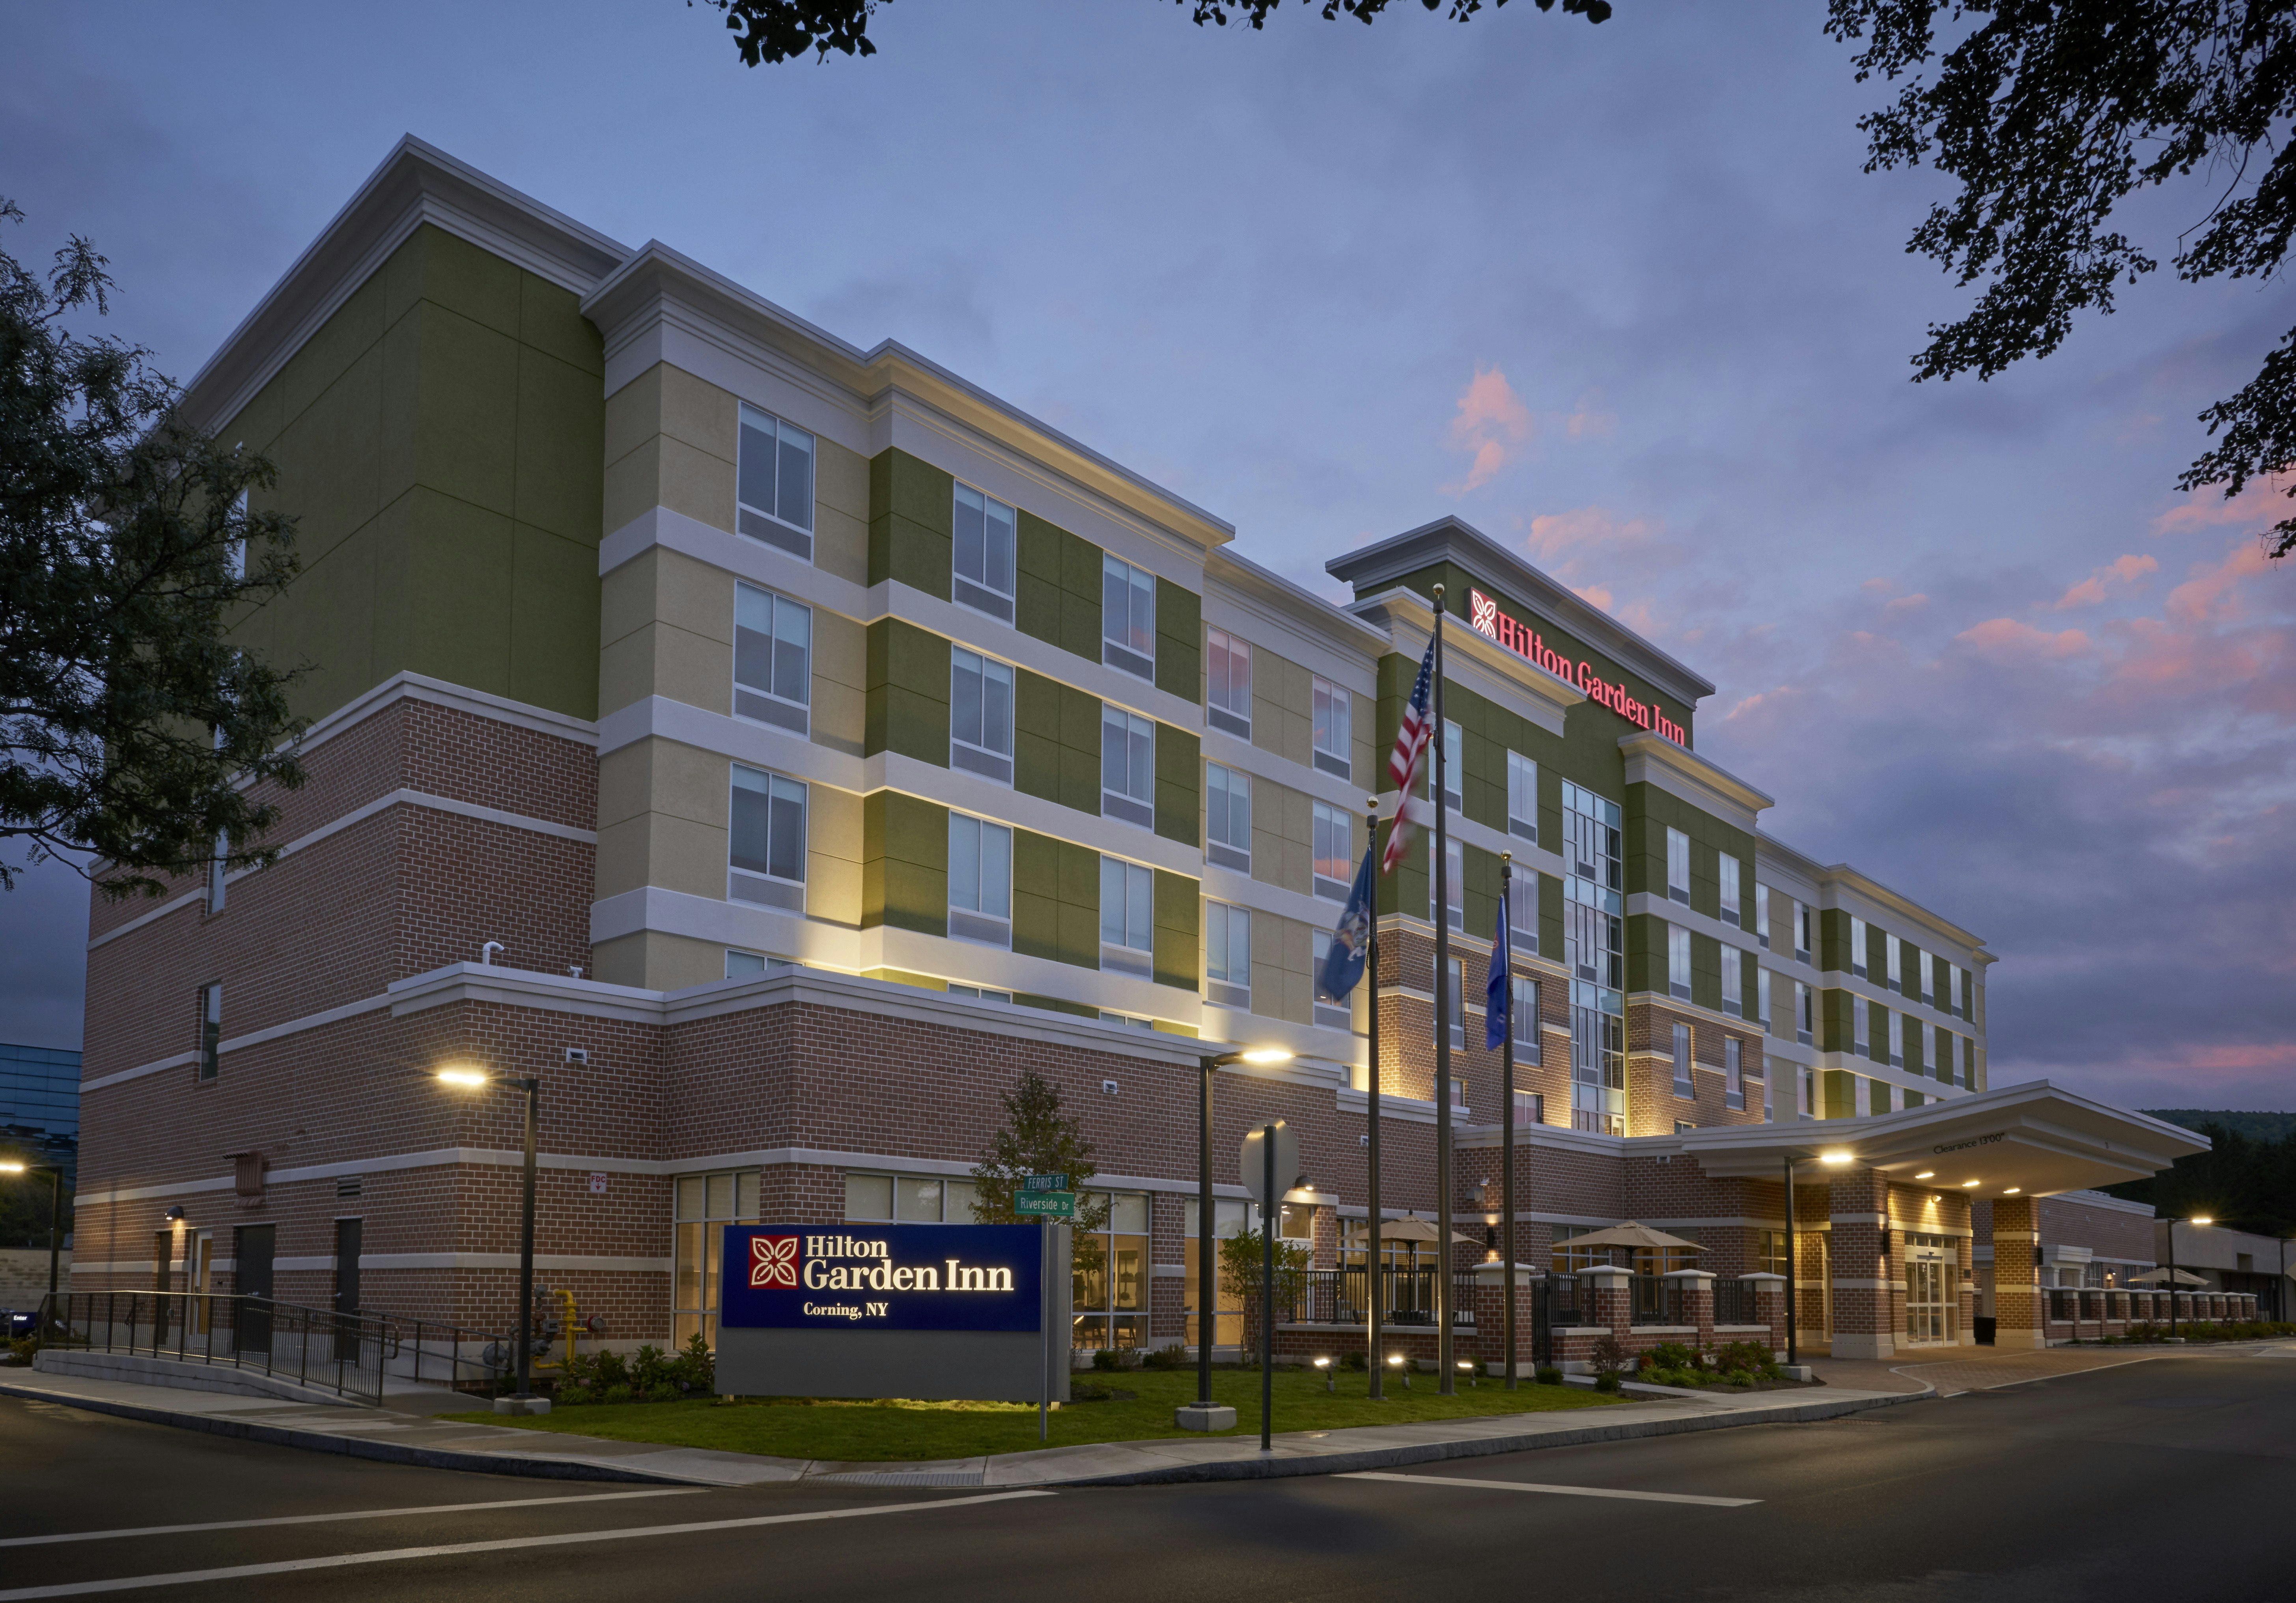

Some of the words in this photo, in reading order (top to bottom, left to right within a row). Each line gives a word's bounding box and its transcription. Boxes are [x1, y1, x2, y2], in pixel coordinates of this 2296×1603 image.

[1498, 611, 1572, 682] Hilton
[1578, 662, 1650, 729] Garden
[1654, 704, 1684, 746] Inn
[1934, 1140, 1977, 1154] Clearance
[1028, 1177, 1052, 1189] FERRIS
[1055, 1176, 1064, 1188] ST
[1021, 1197, 1057, 1210] Riverside
[1062, 1202, 1068, 1210] Dr
[805, 1236, 889, 1257] Hilton
[804, 1259, 940, 1290] Garden
[945, 1260, 1014, 1291] Inn
[804, 1302, 862, 1320] Corning,
[866, 1303, 889, 1316] NY
